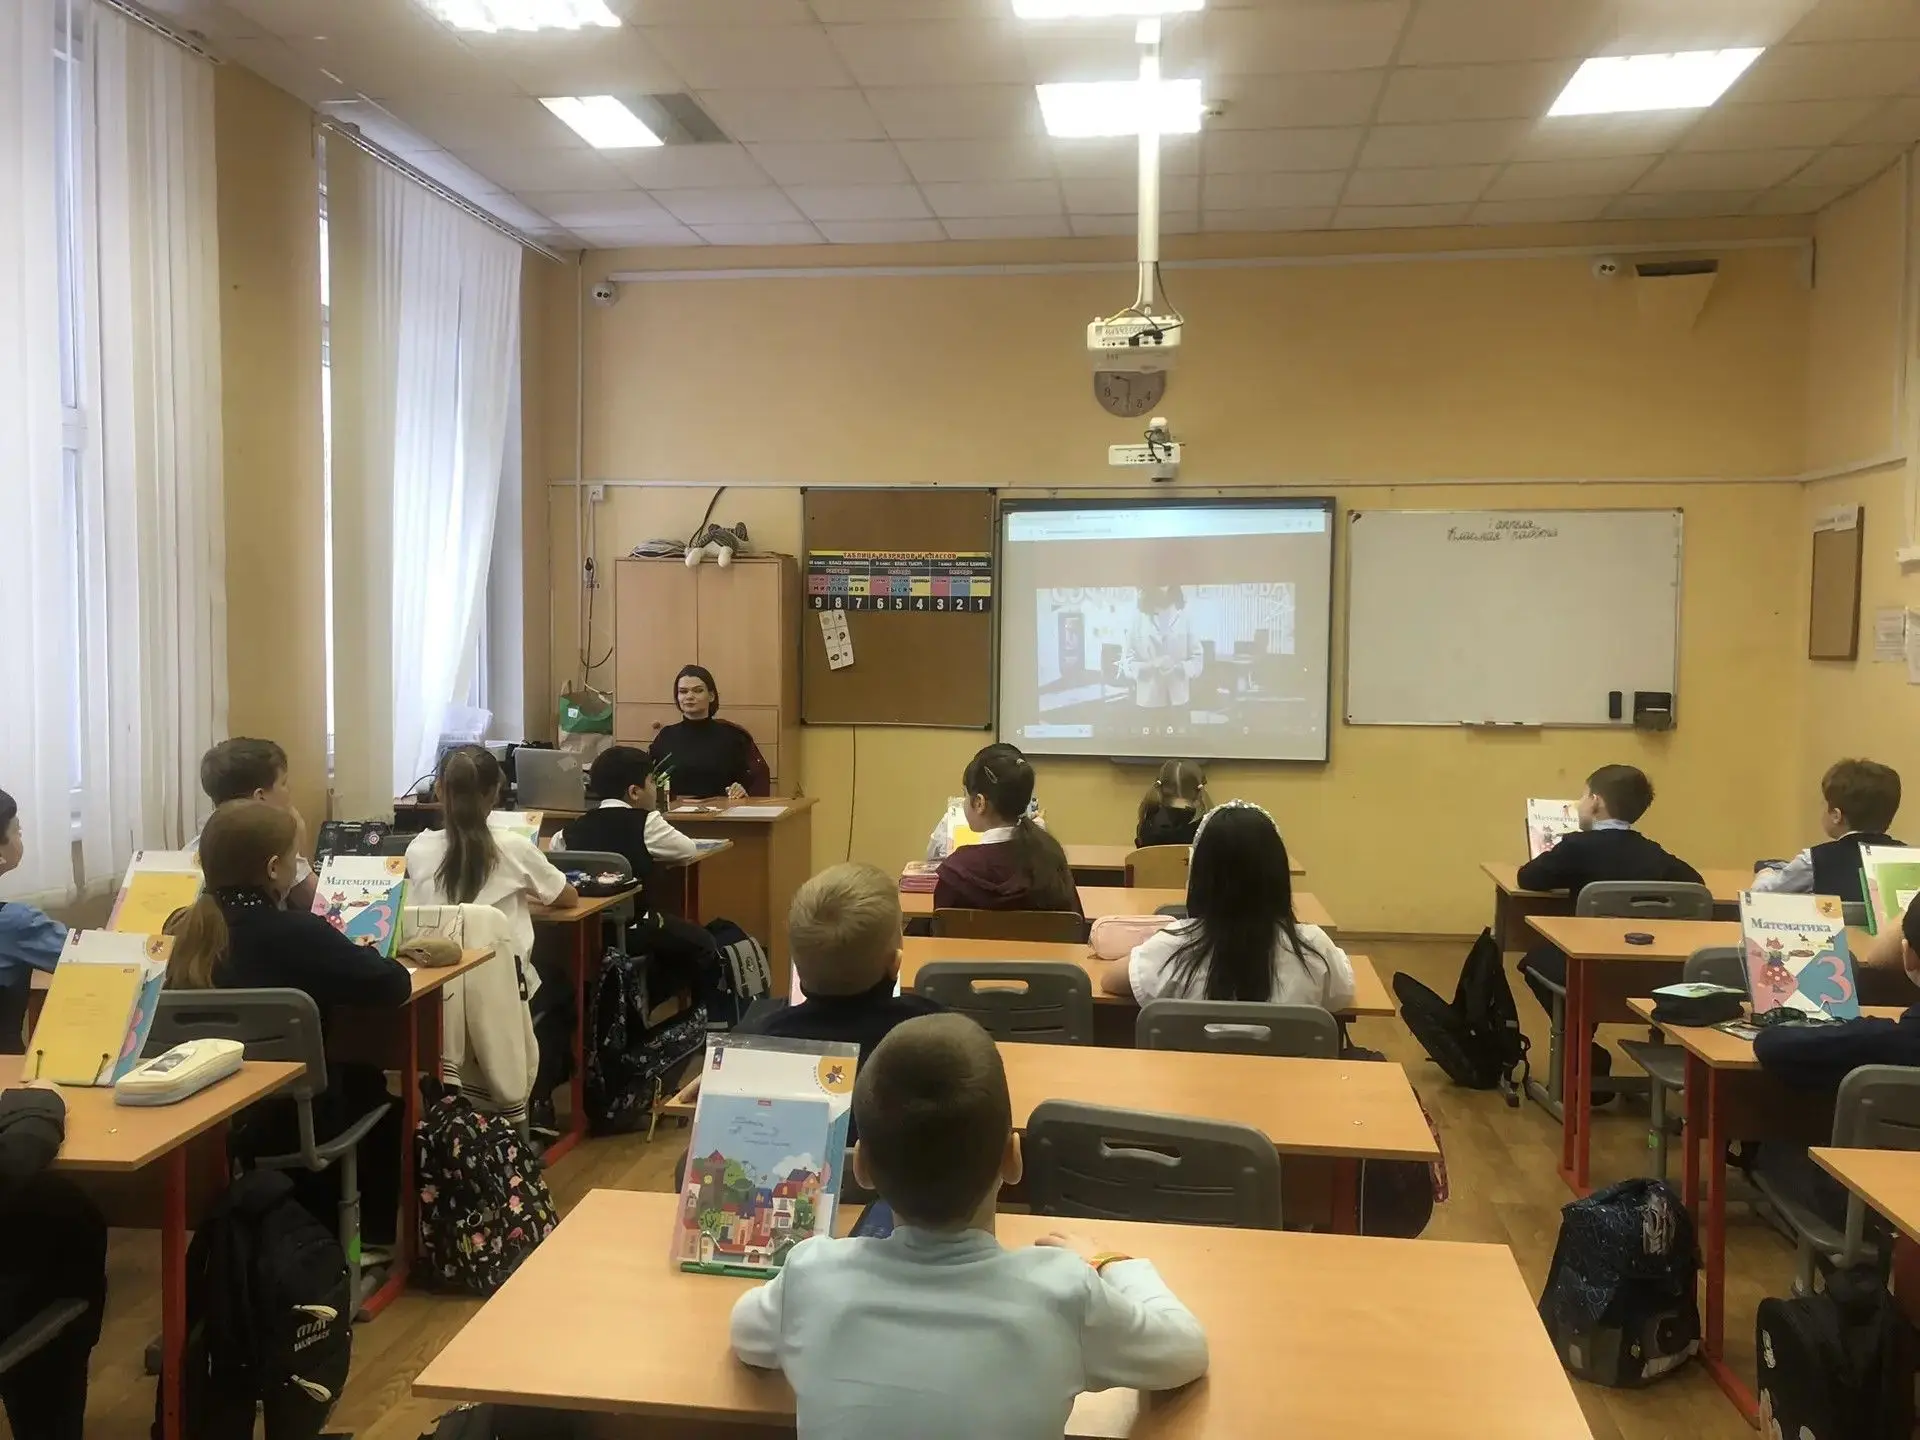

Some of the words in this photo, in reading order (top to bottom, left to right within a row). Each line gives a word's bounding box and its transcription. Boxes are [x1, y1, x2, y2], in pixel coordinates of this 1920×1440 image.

[878, 552, 916, 560] РАЗРЯДОВ
[924, 552, 957, 560] КЛАССОВ
[815, 597, 822, 608] 9
[835, 597, 842, 609] 8
[855, 597, 862, 609] 7
[876, 598, 884, 609] 6
[895, 598, 903, 610] 5
[916, 598, 924, 610] 4
[937, 598, 944, 610] 3
[956, 598, 964, 610] 2
[978, 598, 984, 610] 1
[325, 875, 391, 887] Математика
[369, 904, 392, 941] 3
[1750, 917, 1832, 933] Математика
[1817, 956, 1853, 1004] 3
